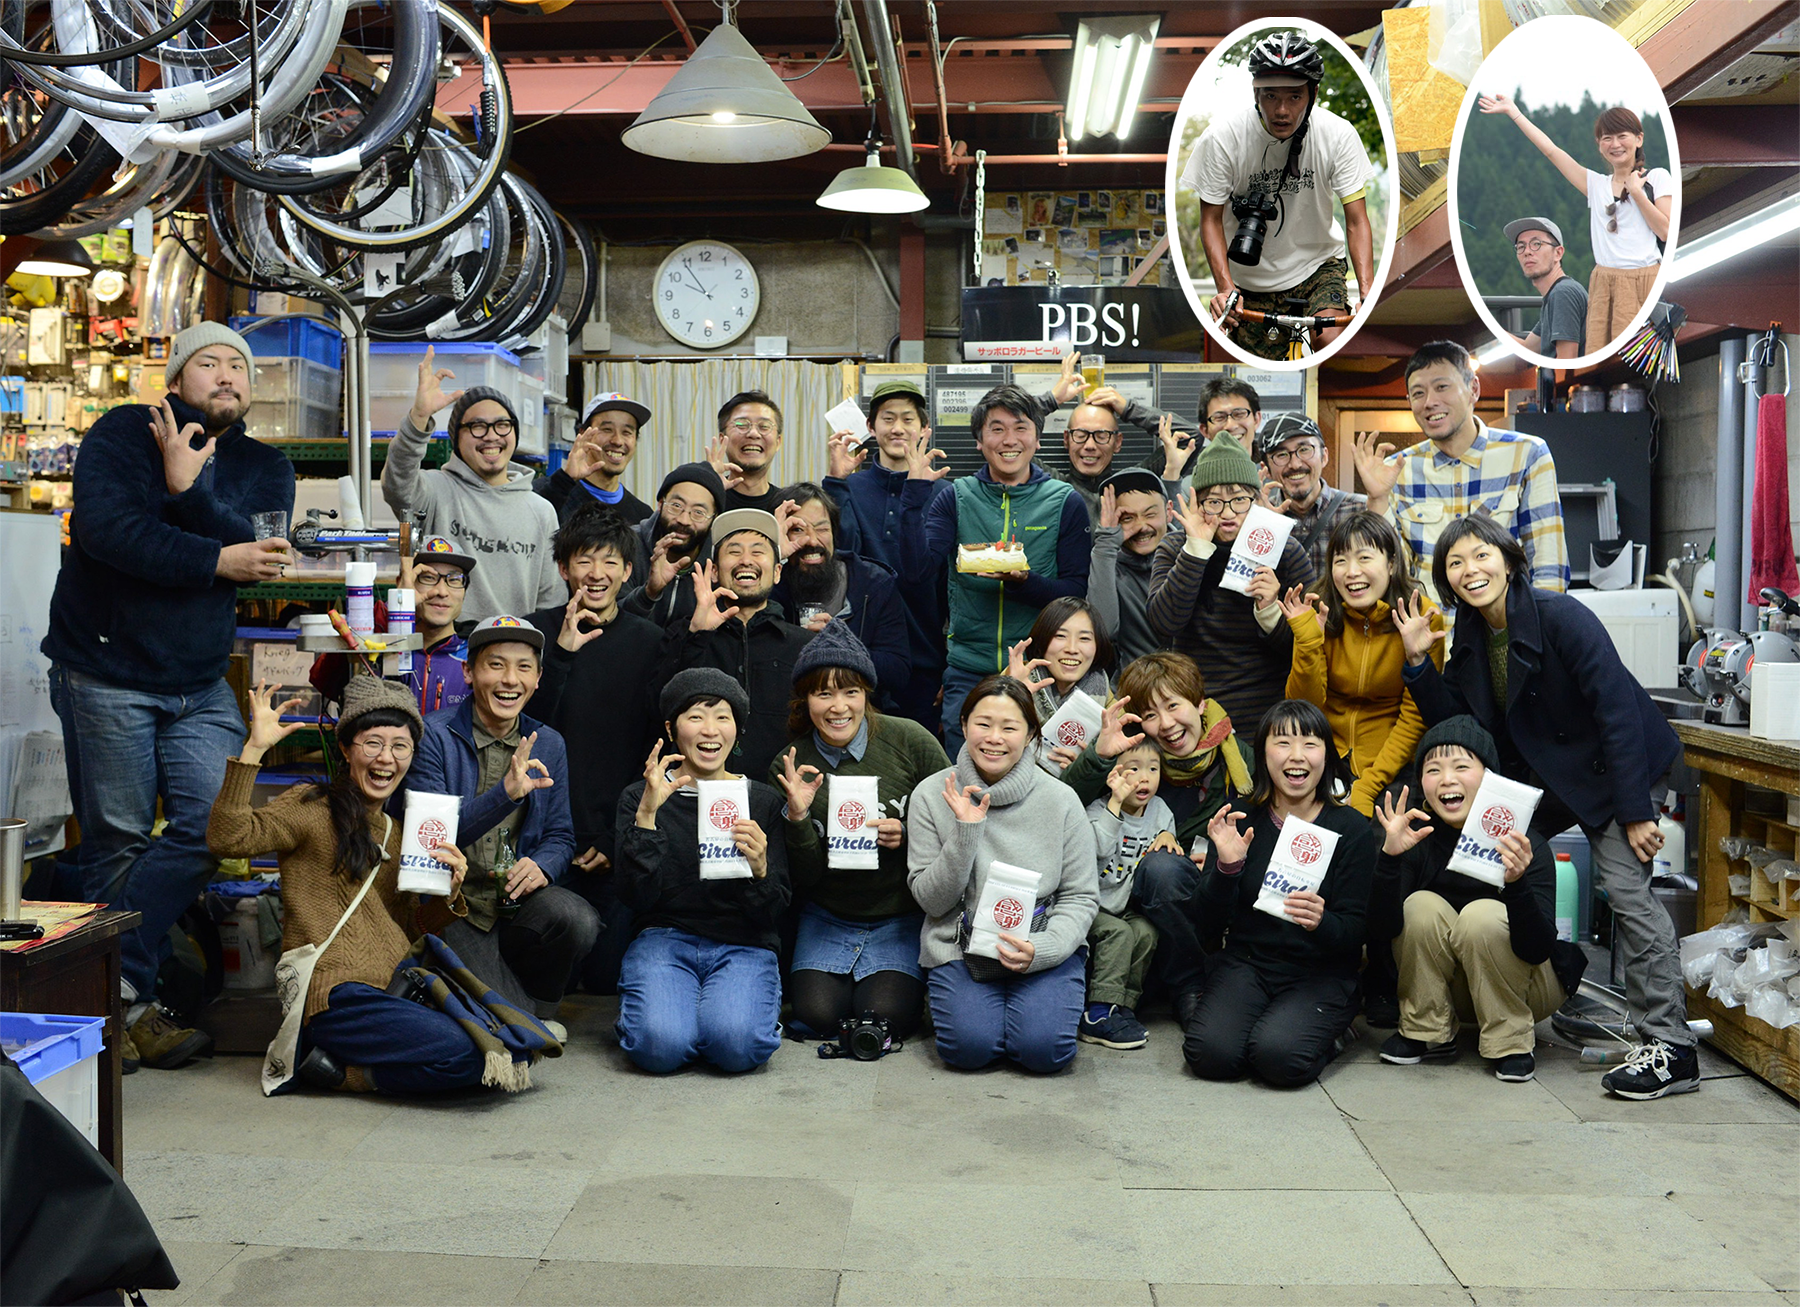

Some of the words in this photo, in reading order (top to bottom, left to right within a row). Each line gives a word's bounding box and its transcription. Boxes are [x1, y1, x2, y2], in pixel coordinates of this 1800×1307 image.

[698, 250, 711, 262] 12
[722, 256, 727, 266] 1
[682, 257, 692, 268] 11
[668, 271, 682, 283] 10
[734, 269, 743, 280] 2
[665, 289, 673, 301] 9
[740, 287, 749, 299] 3
[672, 308, 680, 319] 8
[735, 306, 744, 317] 4
[686, 321, 694, 333] 7
[722, 320, 731, 331] 5
[1038, 302, 1140, 347] PBS!
[704, 325, 712, 337] 6
[977, 346, 1062, 357] サッポロラガービール
[1246, 374, 1272, 383] 003062
